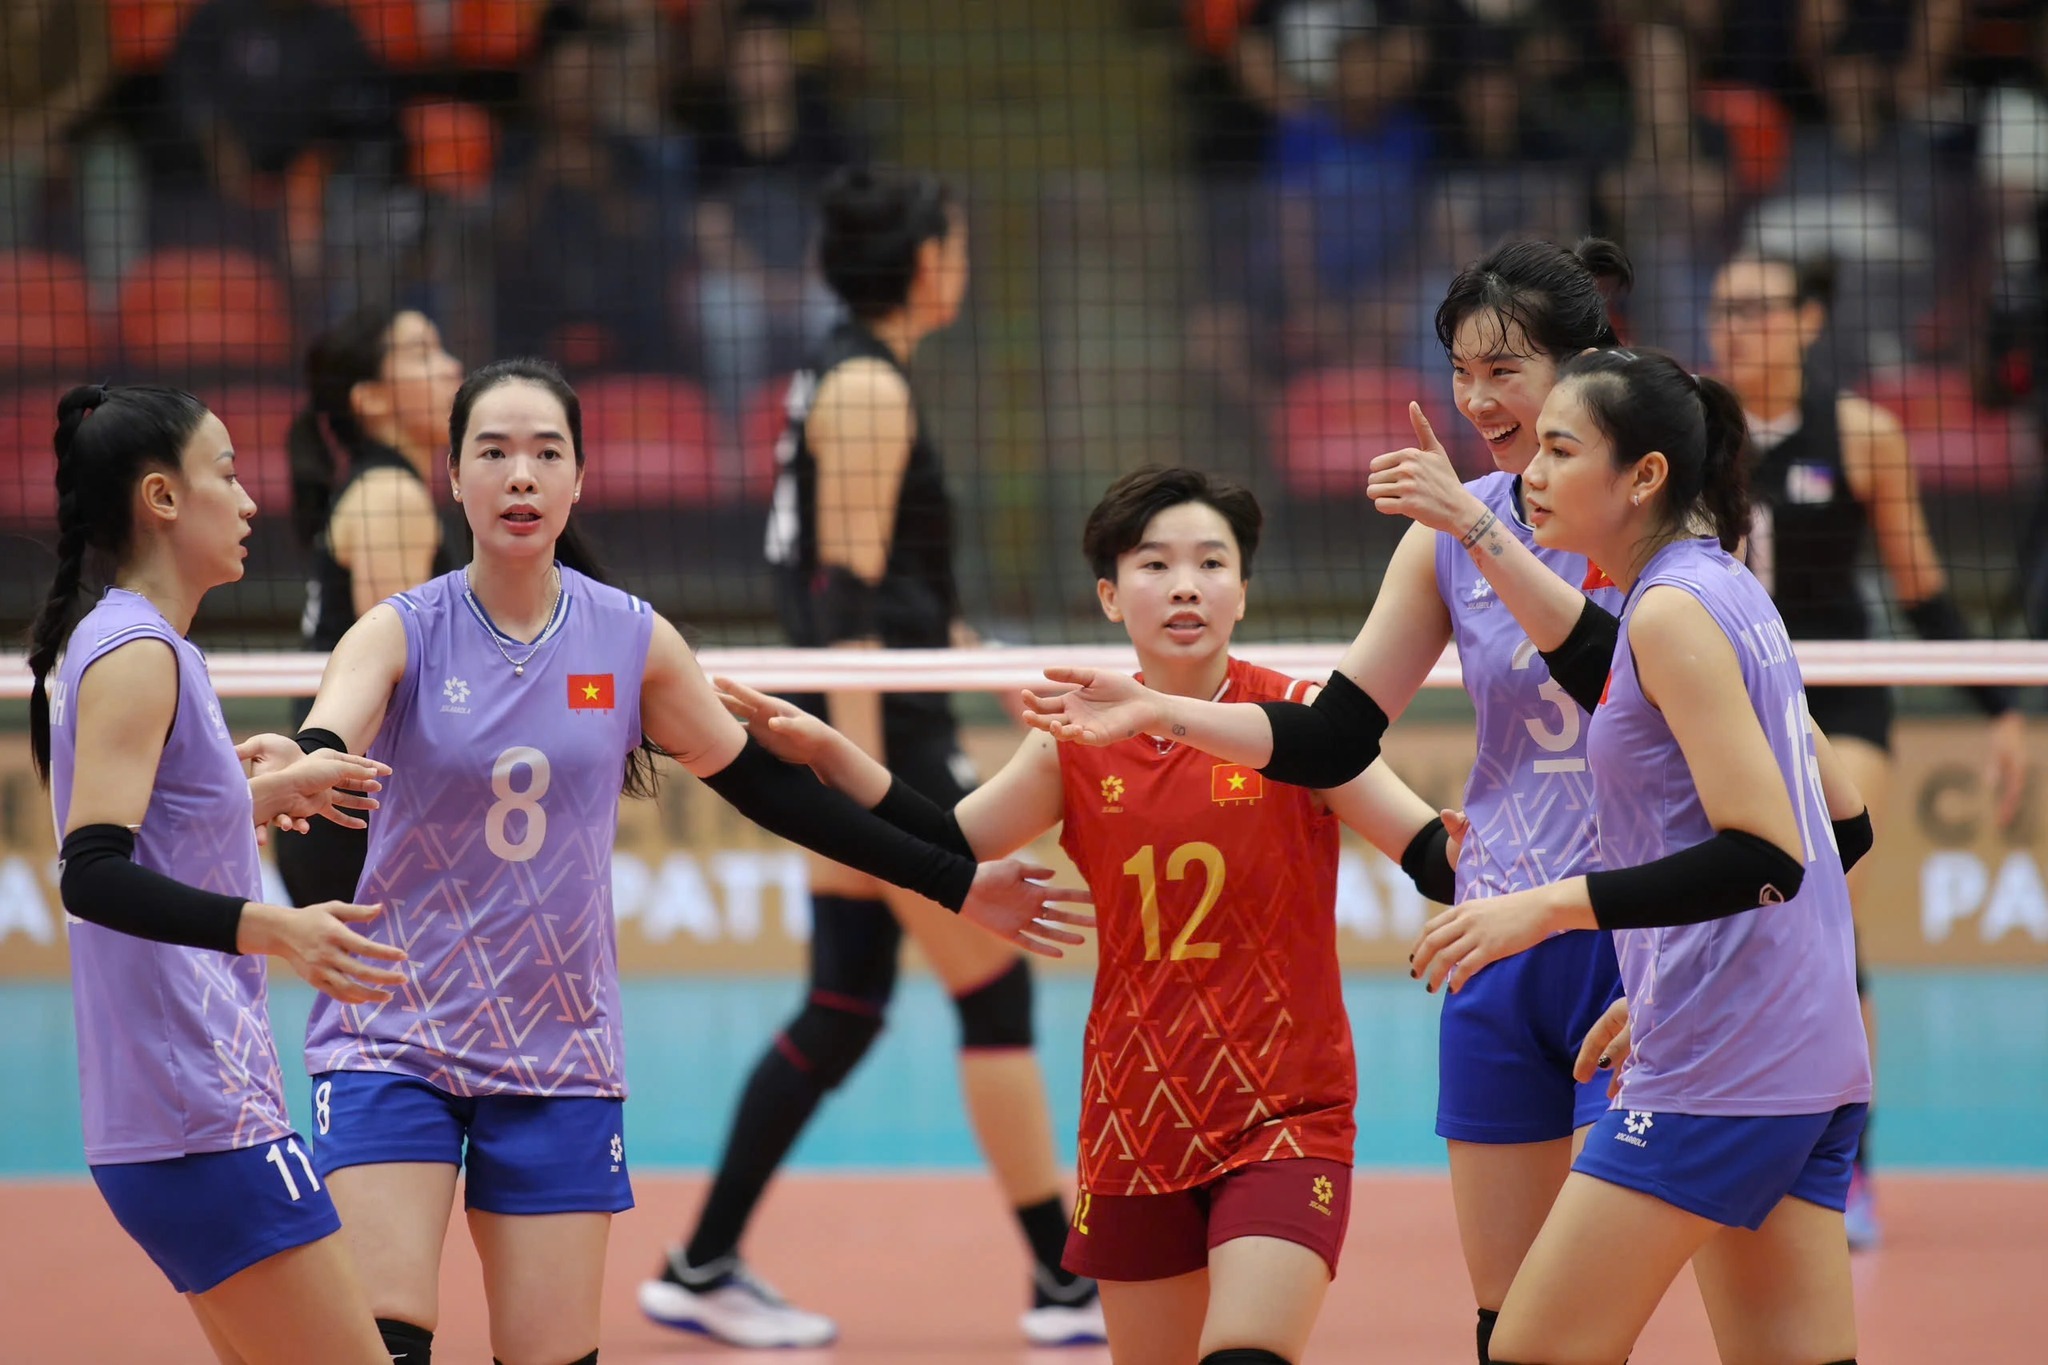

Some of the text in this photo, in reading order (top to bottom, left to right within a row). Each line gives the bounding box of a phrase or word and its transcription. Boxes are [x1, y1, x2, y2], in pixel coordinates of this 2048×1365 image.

[1511, 637, 1580, 752] 3
[484, 745, 551, 862] 8
[1122, 840, 1227, 962] 12
[315, 1080, 333, 1136] 8
[265, 1137, 321, 1202] 11
